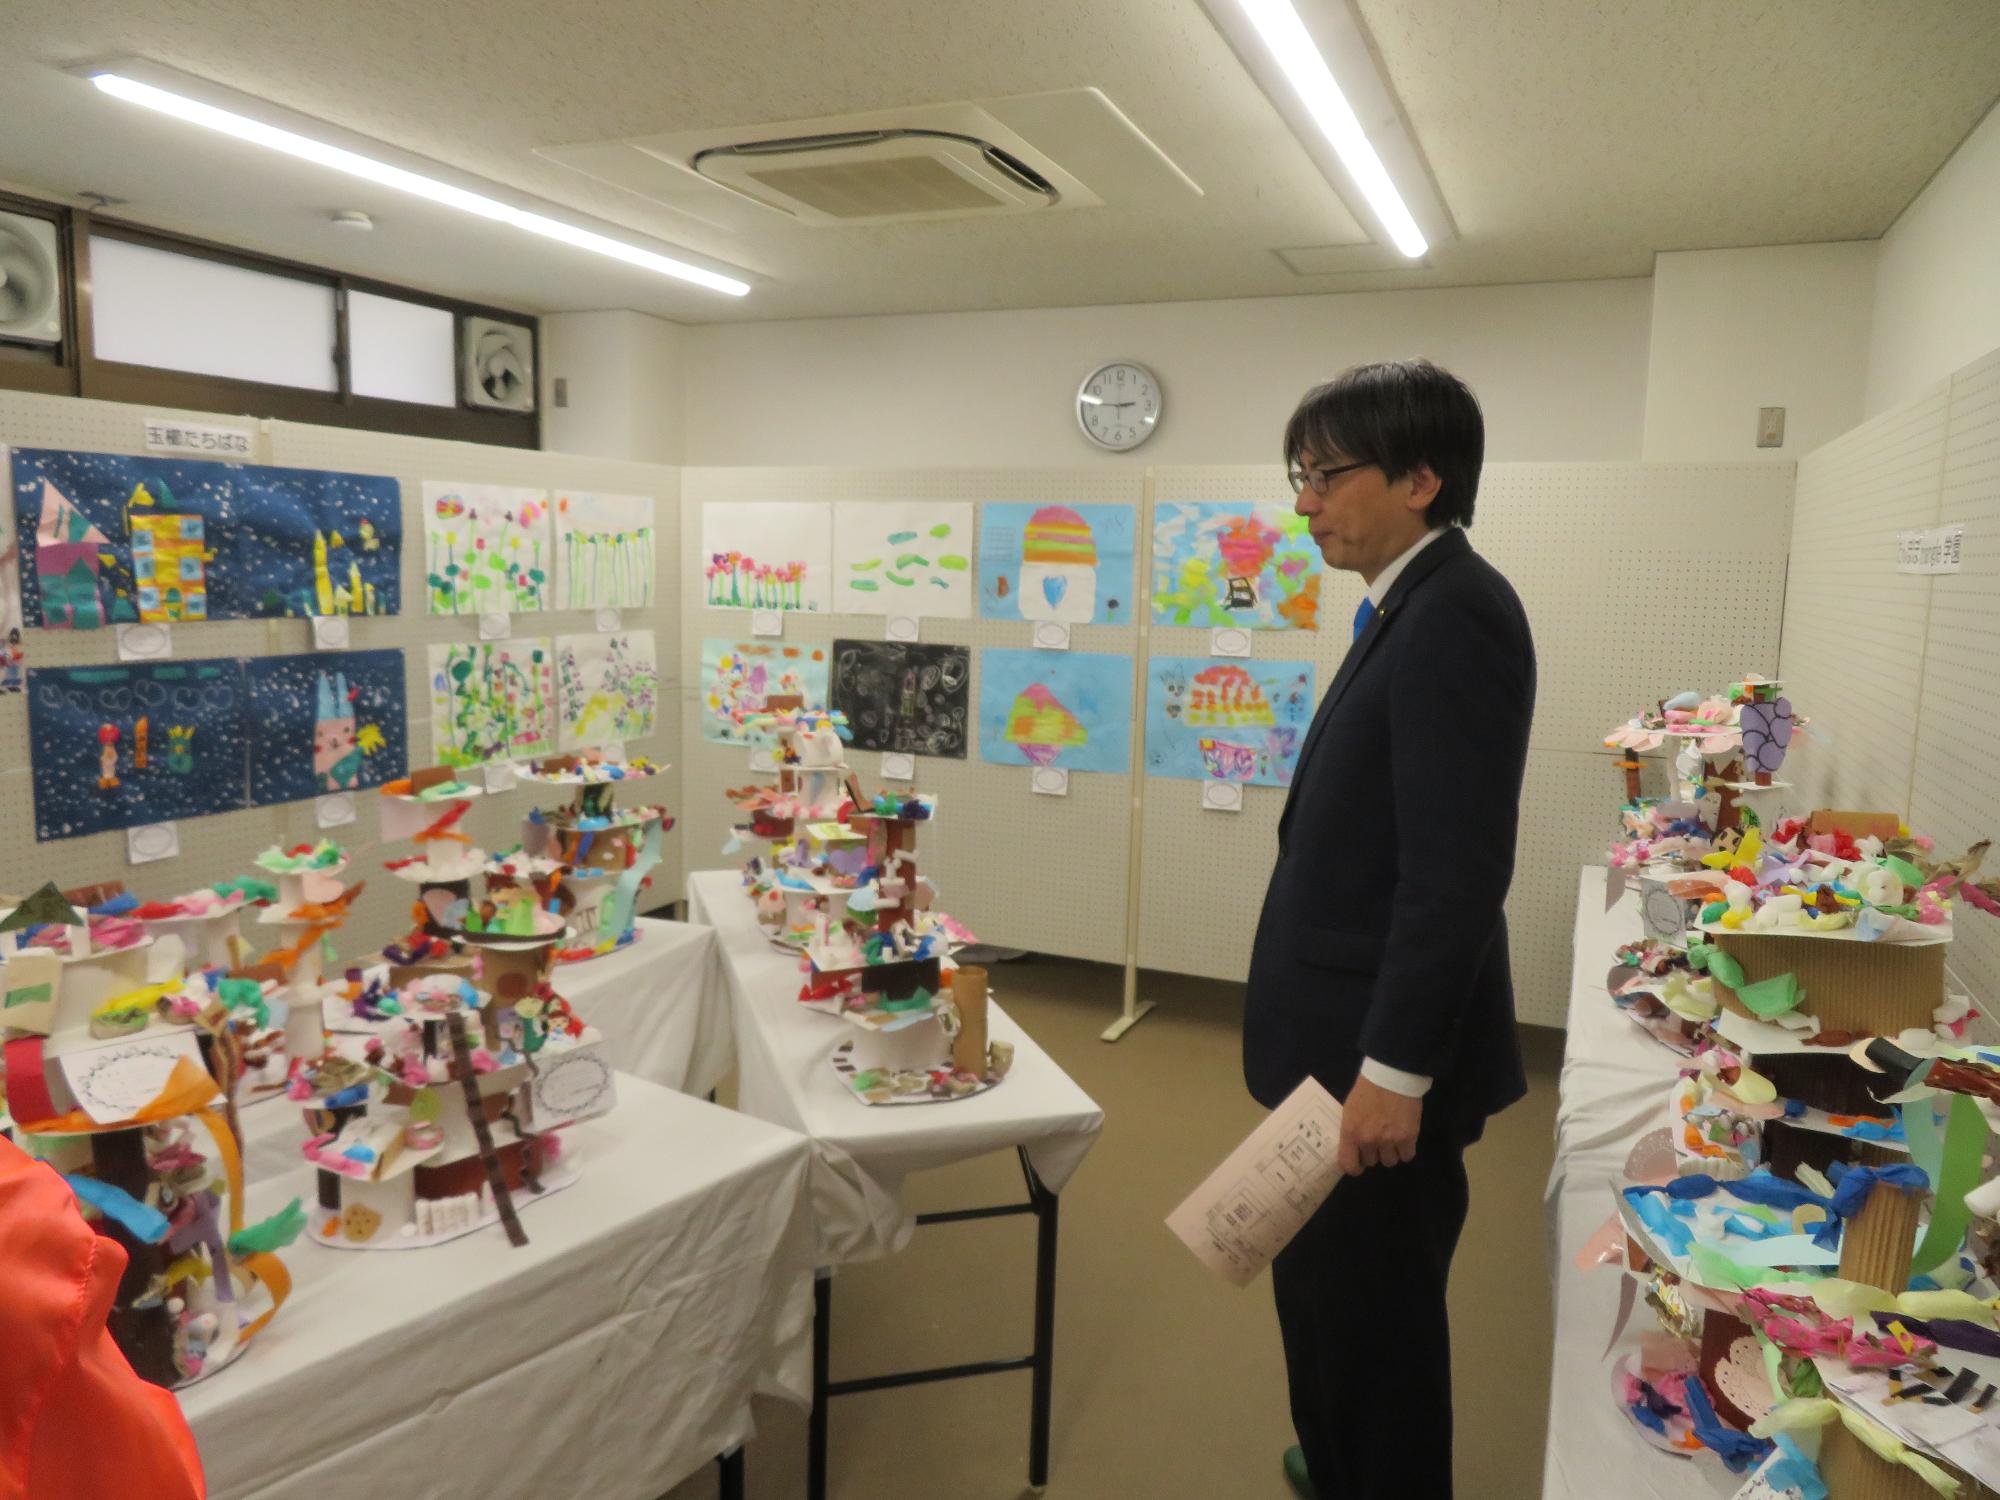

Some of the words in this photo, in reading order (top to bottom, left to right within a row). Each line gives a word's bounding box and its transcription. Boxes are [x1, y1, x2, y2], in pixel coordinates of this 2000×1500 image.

[1104, 374, 1112, 385] 11
[1116, 369, 1125, 381] 12
[1132, 374, 1137, 385] 1
[1093, 385, 1102, 395] 10
[1141, 384, 1149, 395] 2
[1144, 400, 1152, 411] 3
[1091, 415, 1099, 426] 8
[1102, 427, 1109, 437] 7
[1114, 430, 1122, 441] 6
[1129, 427, 1137, 439] 5
